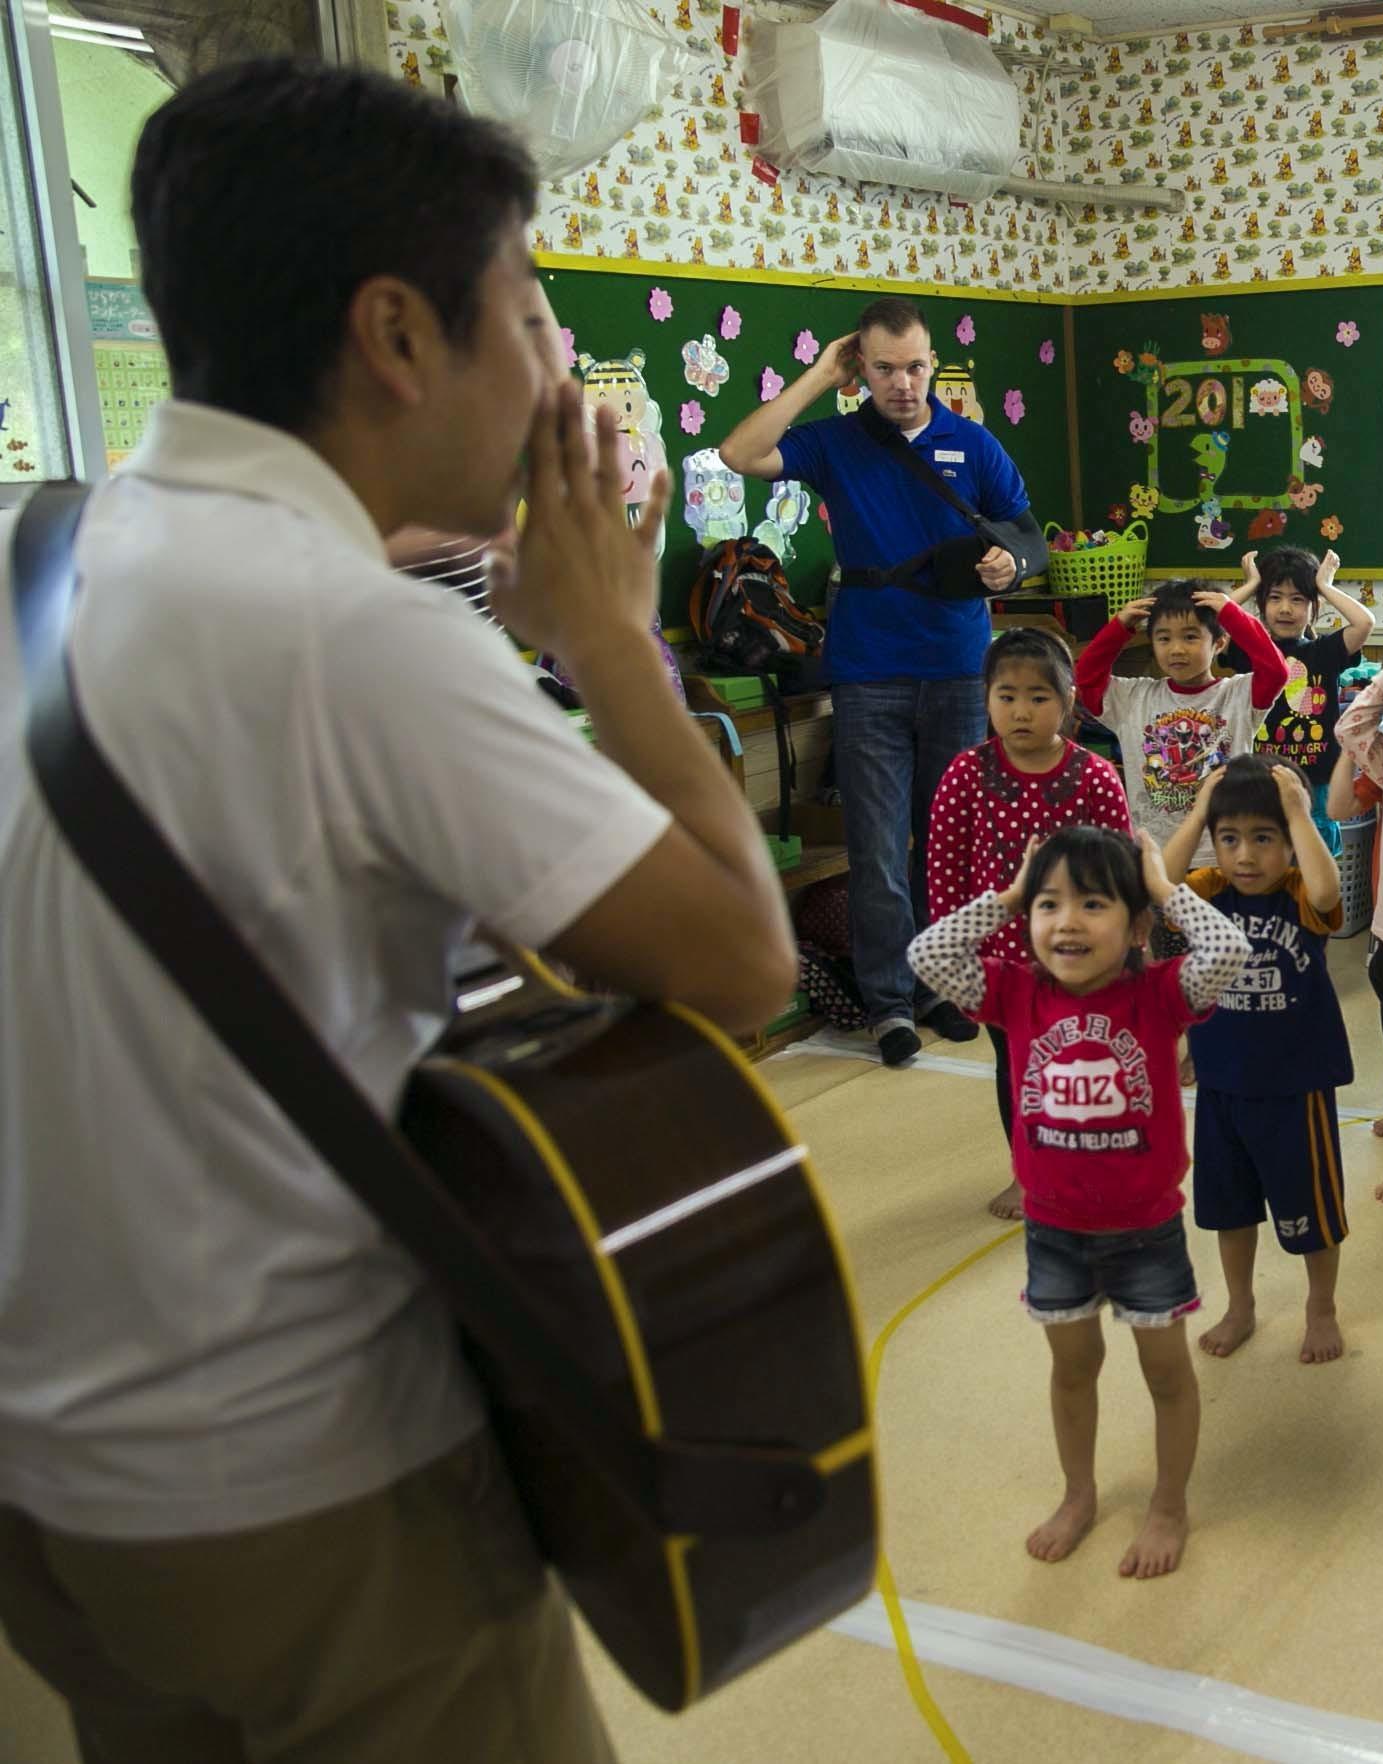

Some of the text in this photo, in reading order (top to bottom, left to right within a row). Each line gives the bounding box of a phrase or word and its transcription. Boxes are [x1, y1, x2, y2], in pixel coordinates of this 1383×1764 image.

[1282, 742, 1329, 755] HUNGRY
[1258, 970, 1275, 990] 57
[1021, 1013, 1152, 1117] UNIVERSITY
[1052, 1074, 1114, 1106] 902
[1110, 1128, 1139, 1148] CLUB
[1279, 1215, 1310, 1238] 52
